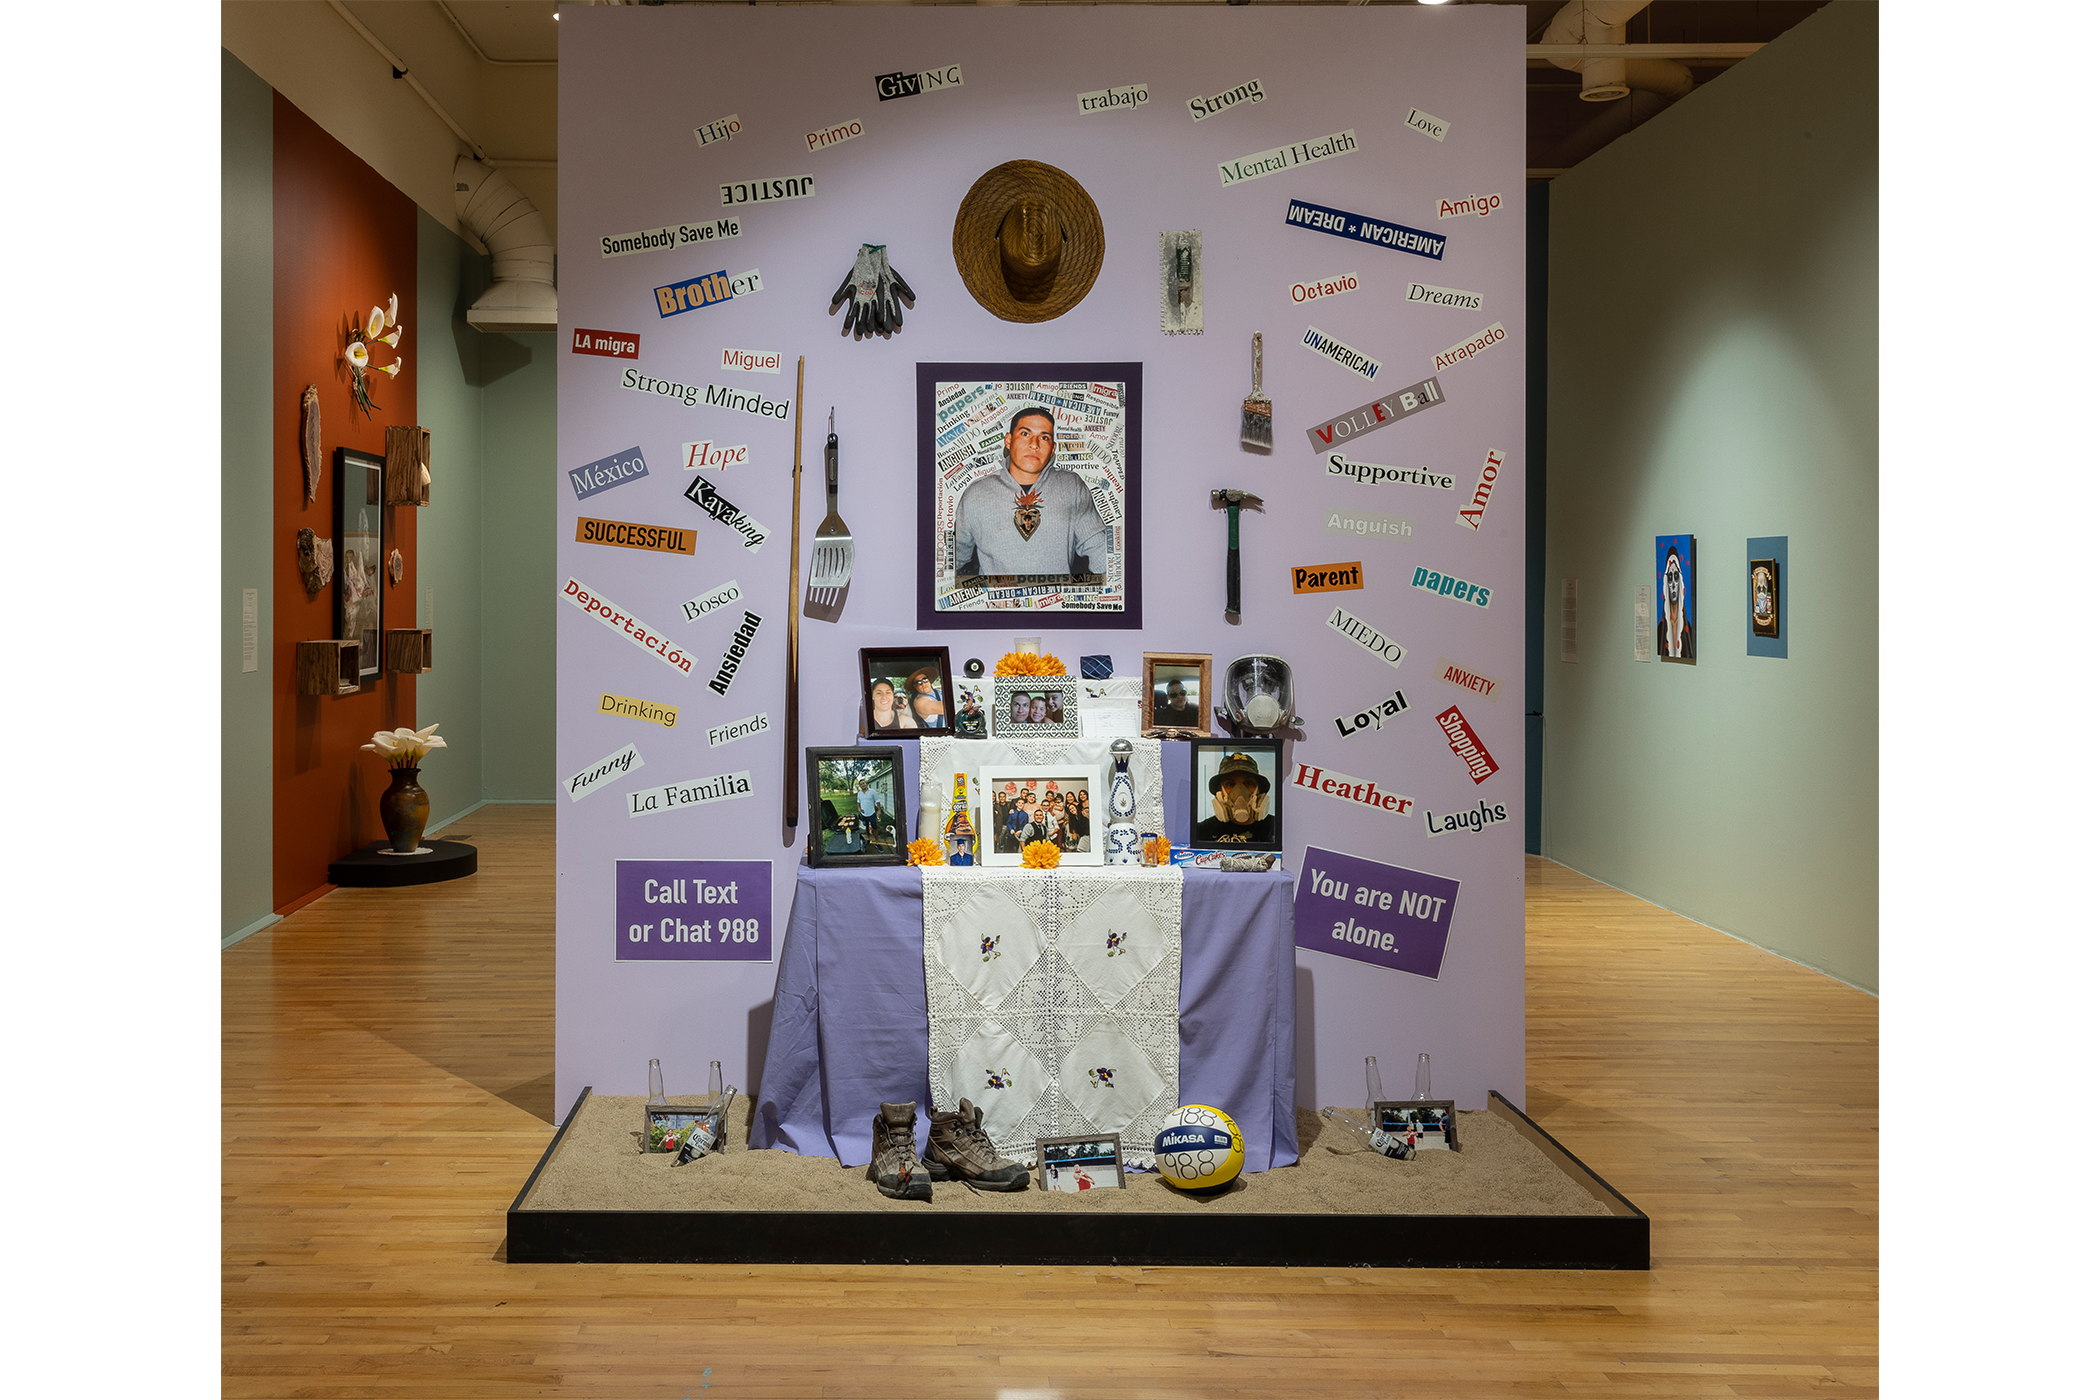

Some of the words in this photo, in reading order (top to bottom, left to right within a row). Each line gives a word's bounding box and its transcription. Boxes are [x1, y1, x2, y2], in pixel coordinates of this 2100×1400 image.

[1081, 86, 1148, 111] trabajo
[1190, 81, 1264, 121] Strong
[696, 116, 742, 146] Hijo
[806, 120, 862, 151] Primo
[1407, 109, 1443, 138] Love
[1221, 151, 1288, 185] Mental
[1291, 133, 1356, 165] Health
[722, 176, 814, 205] JUSTICE
[1439, 194, 1501, 217] Amigo
[1287, 203, 1346, 234] DREAM
[602, 229, 676, 255] Somebody
[679, 222, 714, 245] Save
[717, 218, 740, 239] Me
[1361, 221, 1445, 257] AMERICAN
[657, 271, 759, 317] Brother
[1291, 275, 1358, 303] Octavio
[1407, 283, 1482, 310] Dreams
[575, 333, 591, 349] LA
[595, 335, 636, 356] migra
[1303, 329, 1380, 379] UNAMERICAN
[1435, 326, 1506, 371] Atrapado
[723, 350, 781, 371] Miguel
[622, 368, 699, 407] Strong
[705, 384, 791, 420] Minded
[937, 383, 960, 397] Primo
[1006, 382, 1034, 391] JUSTICE
[1029, 391, 1056, 405] DREAM
[1037, 382, 1059, 392] Amigo
[938, 386, 985, 423] papers
[980, 406, 1009, 426] Atrapado
[1051, 406, 1082, 425] Hope
[1061, 398, 1102, 416] AMERICAN
[1315, 399, 1396, 444] VOLLEY
[1399, 381, 1439, 412] Ball
[937, 410, 971, 434] Drinking
[1085, 415, 1114, 426] JUSTICE
[1090, 432, 1109, 441] Amor
[686, 441, 746, 471] Hope
[1055, 462, 1100, 471] Supportive
[1328, 454, 1452, 489] Supportive
[571, 456, 645, 495] México
[953, 474, 973, 492] Loyal
[1102, 465, 1124, 494] Heather
[1459, 450, 1503, 531] Amor
[688, 478, 765, 548] Kayaking
[1326, 513, 1413, 537] Anguish
[584, 520, 687, 552] SUCCESSFUL
[937, 521, 945, 578] OUTDOORS
[1022, 584, 1061, 597] AMERICAN
[1294, 565, 1359, 590] Parent
[1412, 566, 1492, 608] papers
[682, 587, 740, 622] Bosco
[988, 589, 1016, 600] DREAM
[1061, 601, 1095, 610] Somebody
[564, 580, 692, 673] Deportación
[1330, 609, 1402, 663] MIEDO
[707, 610, 763, 697] Ansiedad
[1443, 665, 1496, 697] ANXIETY
[601, 694, 677, 727] Drinking
[1334, 690, 1409, 738] Loyal
[709, 714, 769, 746] Friends
[1439, 712, 1493, 780] Shopping
[571, 749, 637, 794] Funny
[632, 792, 659, 814] La
[664, 773, 752, 807] Familia
[1294, 763, 1413, 815] Heather
[1426, 800, 1508, 834] Laughs
[644, 879, 688, 904] Call
[693, 879, 738, 904] Text
[1311, 867, 1350, 902] You
[1354, 885, 1394, 911] are
[1398, 889, 1447, 922] NOT
[629, 923, 653, 943] or
[660, 918, 712, 943] Chat
[718, 918, 760, 943] 988
[1331, 917, 1400, 954] alone.
[1171, 1106, 1218, 1127] 988
[1164, 1149, 1216, 1181] 988
